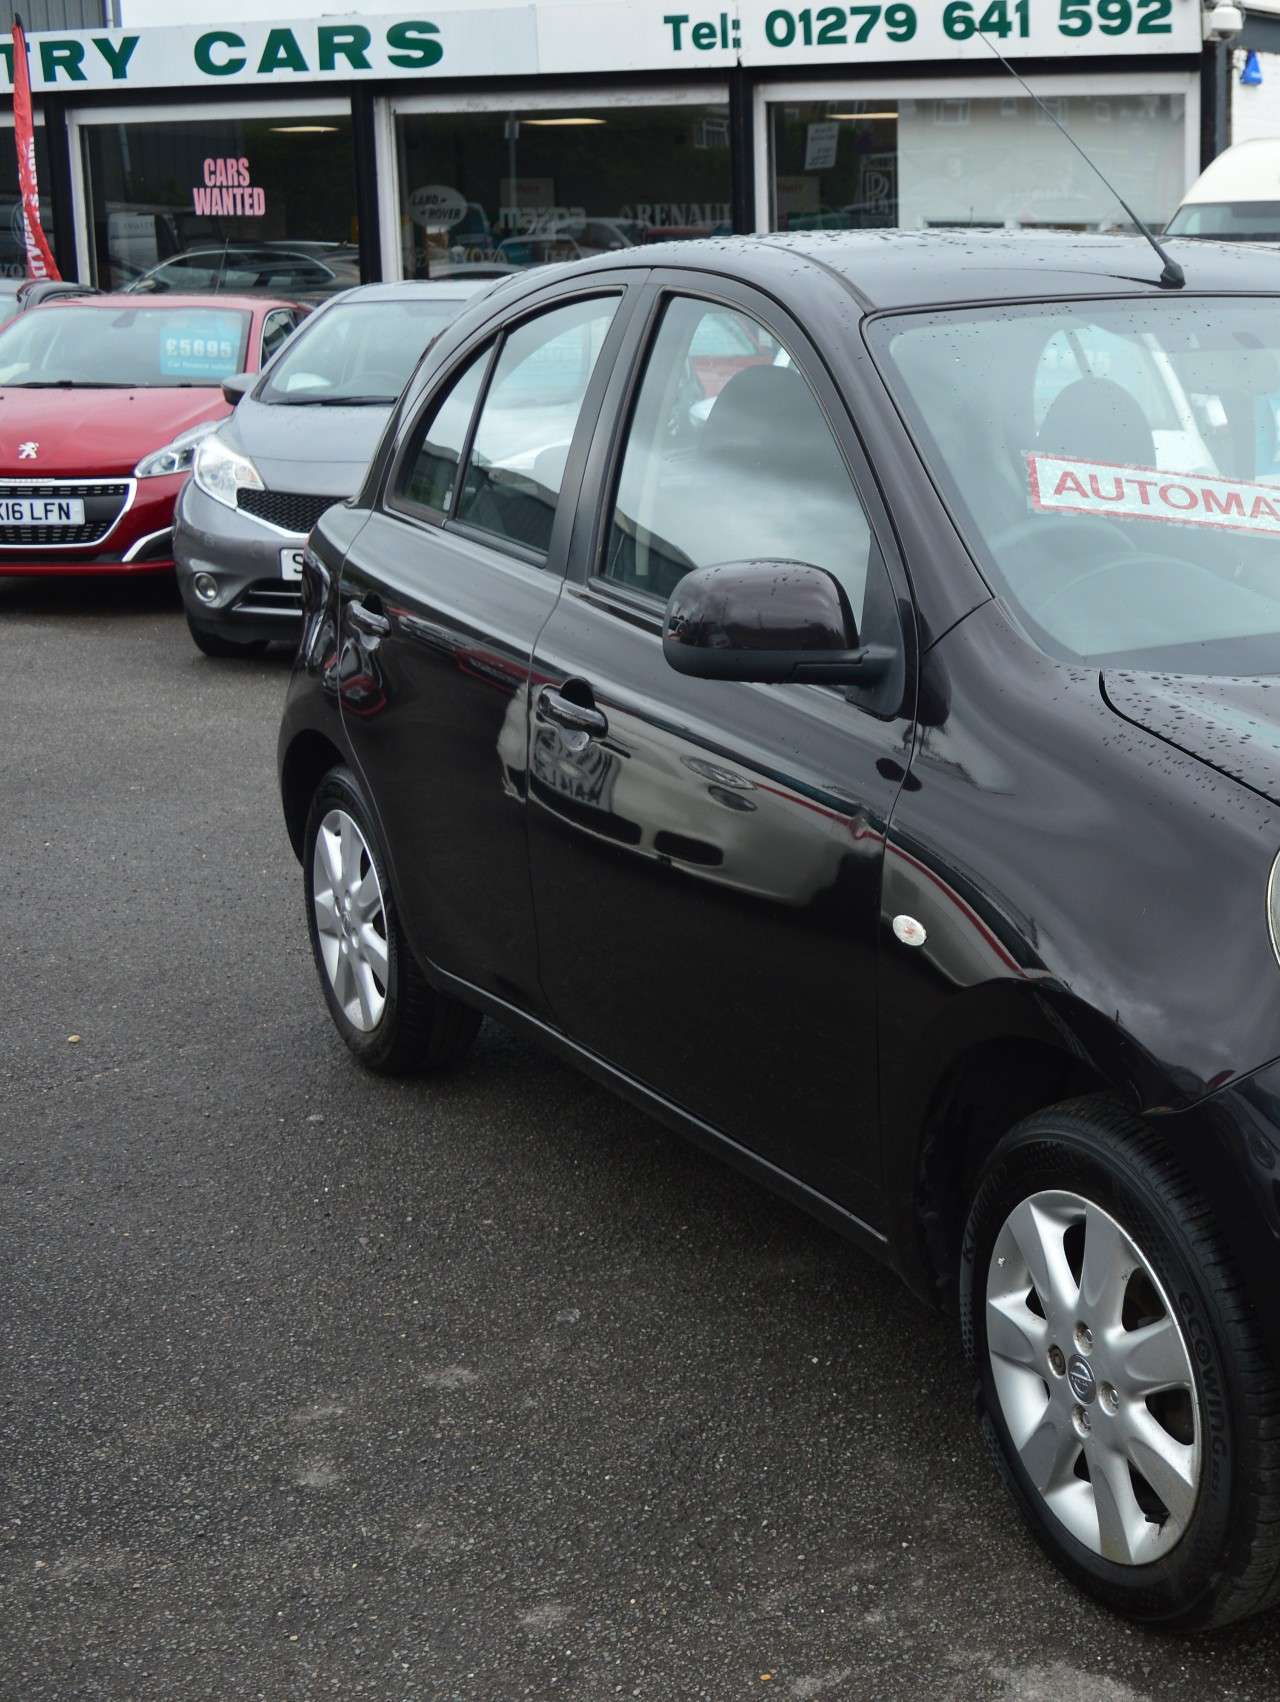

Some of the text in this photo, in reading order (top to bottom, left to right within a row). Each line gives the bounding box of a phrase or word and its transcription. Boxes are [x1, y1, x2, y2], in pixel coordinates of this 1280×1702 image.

[663, 0, 1173, 51] Tel: 01279 641 592
[194, 20, 444, 76] CARS
[203, 157, 250, 187] CARS
[193, 187, 266, 216] WANTED
[29, 502, 71, 521] LFN
